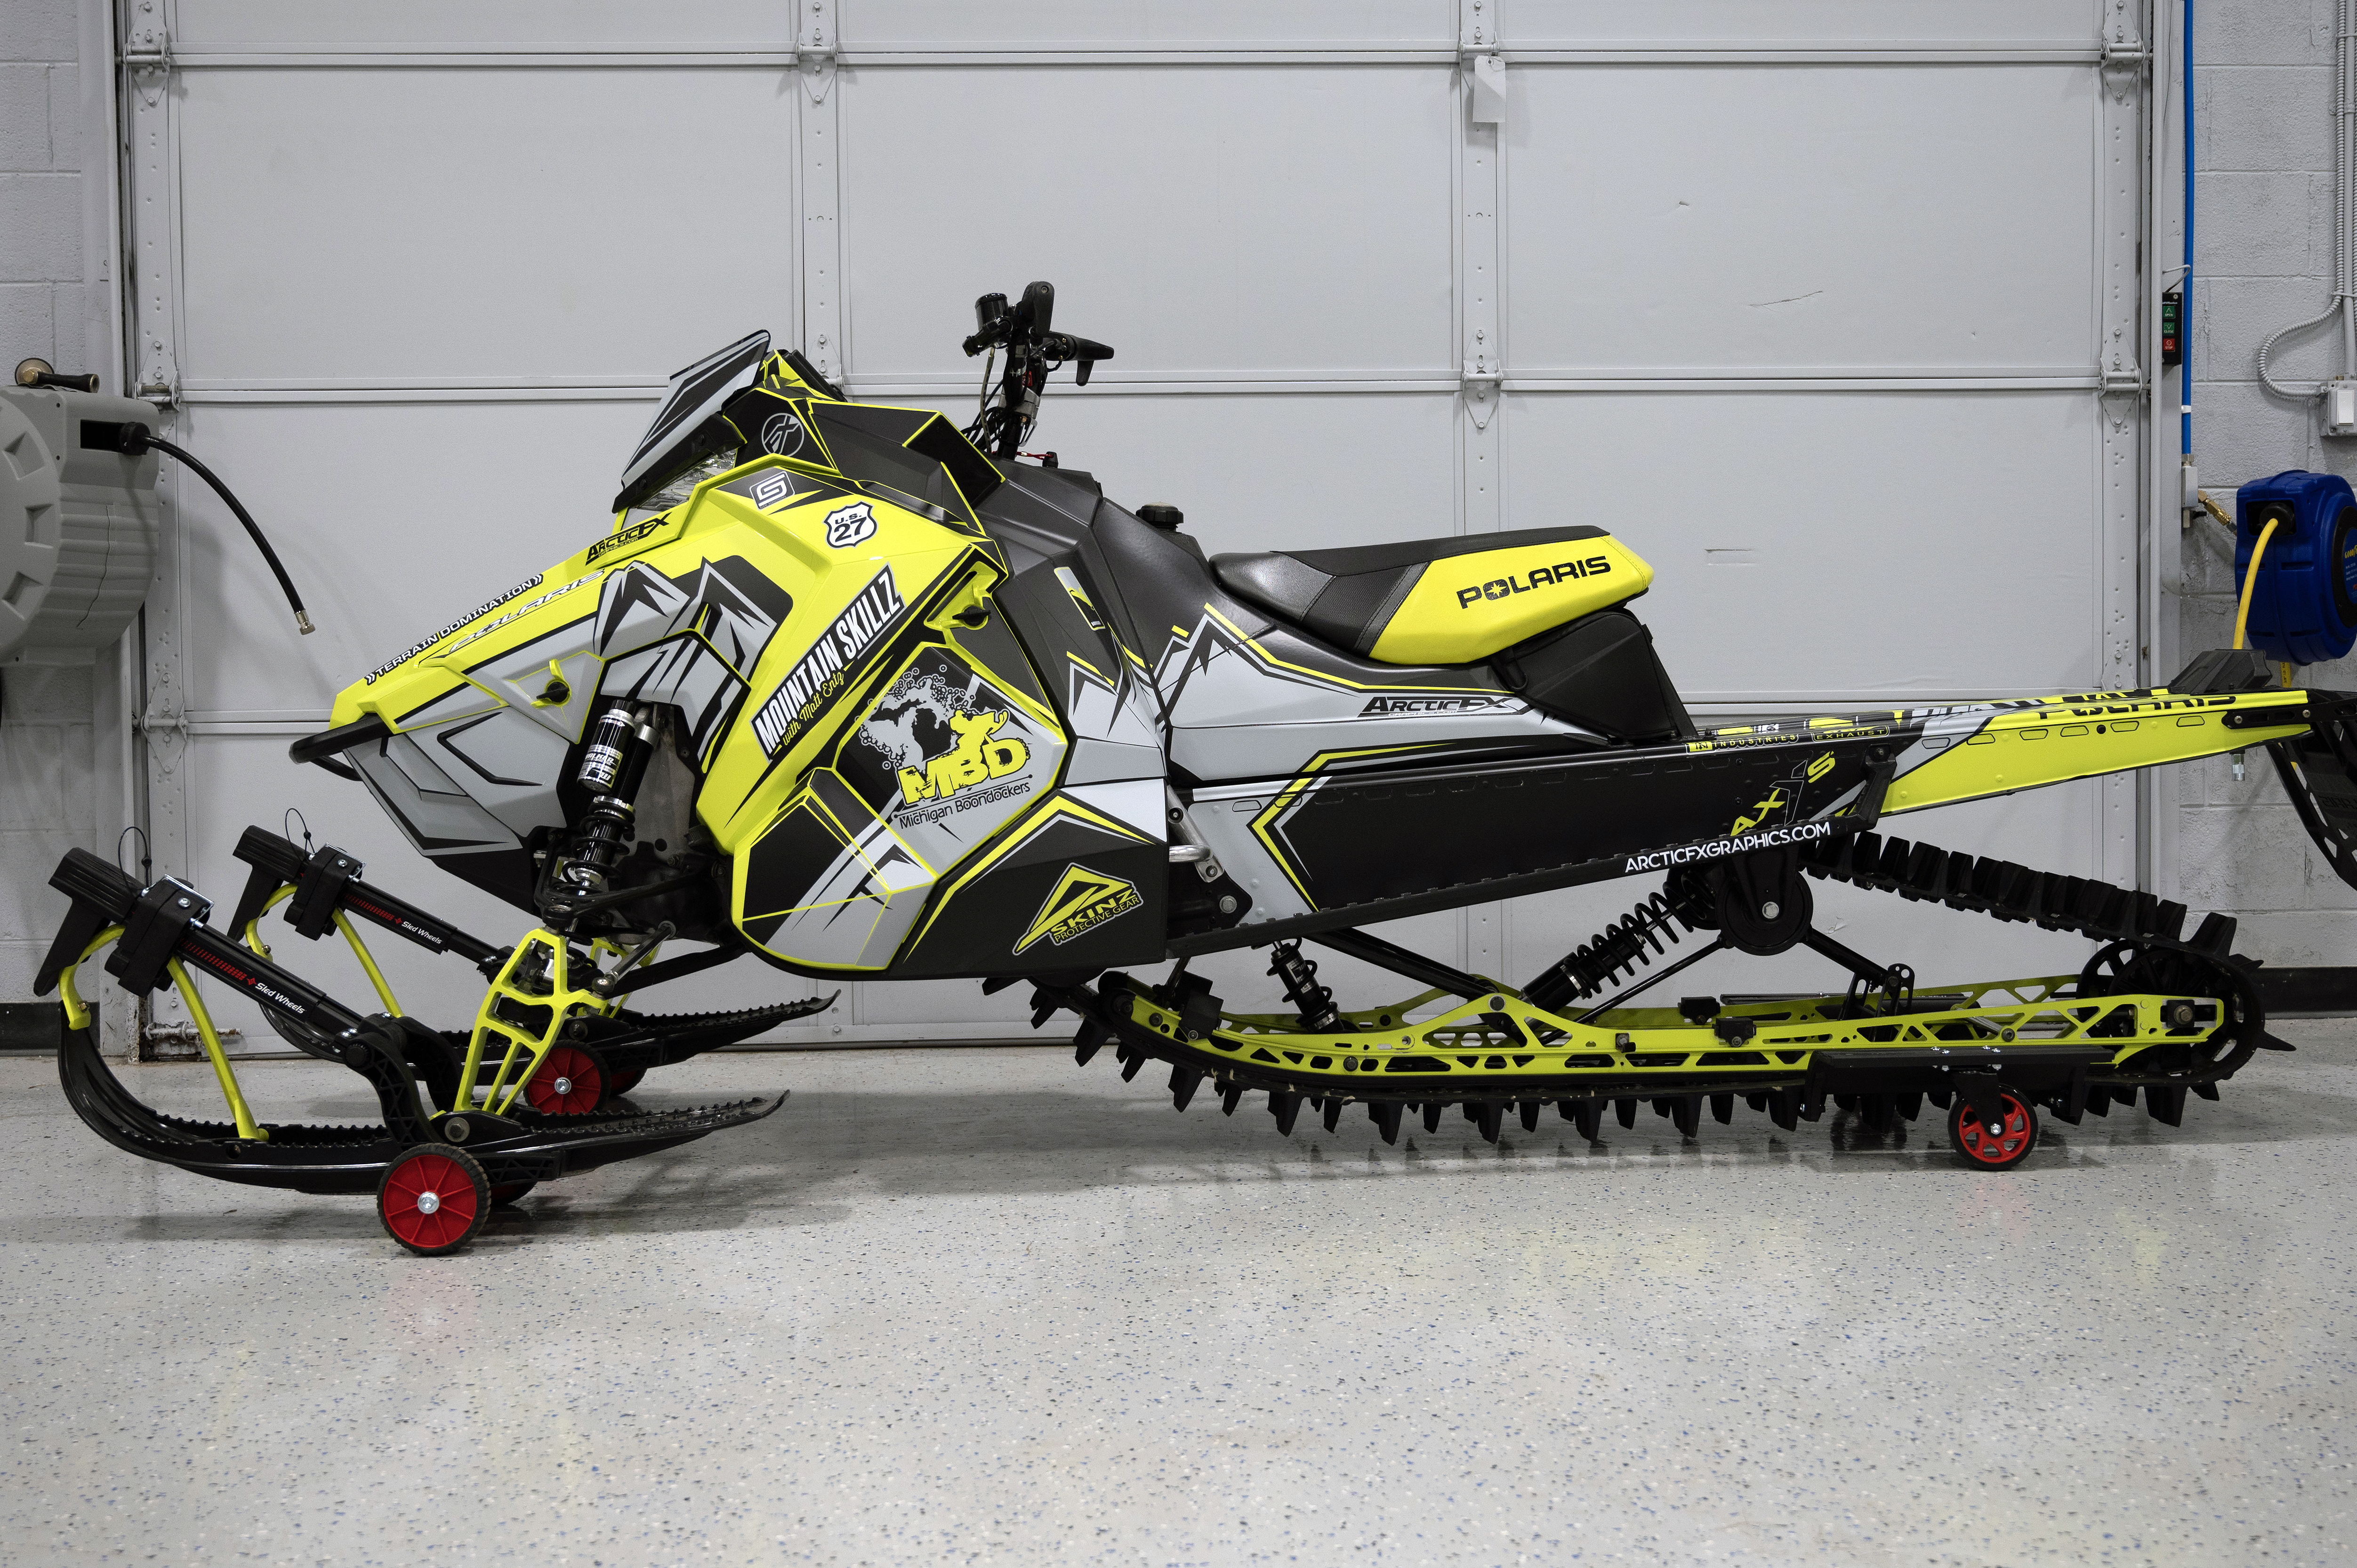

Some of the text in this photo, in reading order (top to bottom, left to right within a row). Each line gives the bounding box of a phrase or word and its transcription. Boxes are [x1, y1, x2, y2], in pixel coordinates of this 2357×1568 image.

[834, 516, 867, 542] 27
[835, 513, 862, 524] U.S.
[1456, 555, 1611, 609] POLARIS
[375, 579, 533, 676] TERRAIN DOMINATION
[449, 568, 605, 653] POLARIS
[755, 571, 901, 754] MOUNTAIN SKILLZ
[783, 672, 844, 746] with Matt Entz
[1713, 734, 1795, 748] INDUSTRIES
[1817, 730, 1884, 740] EXHAUST
[898, 739, 1027, 804] MBD
[900, 782, 1030, 829] Michigan Boondockers
[1625, 821, 1831, 873] ARCTICFXGRAPHICS.COM
[402, 921, 442, 944] Sled Wheels
[1051, 889, 1135, 936] SKINZ
[1054, 897, 1139, 942] PROTECTIVE GEAR
[255, 982, 306, 1014] Sled Wheels
